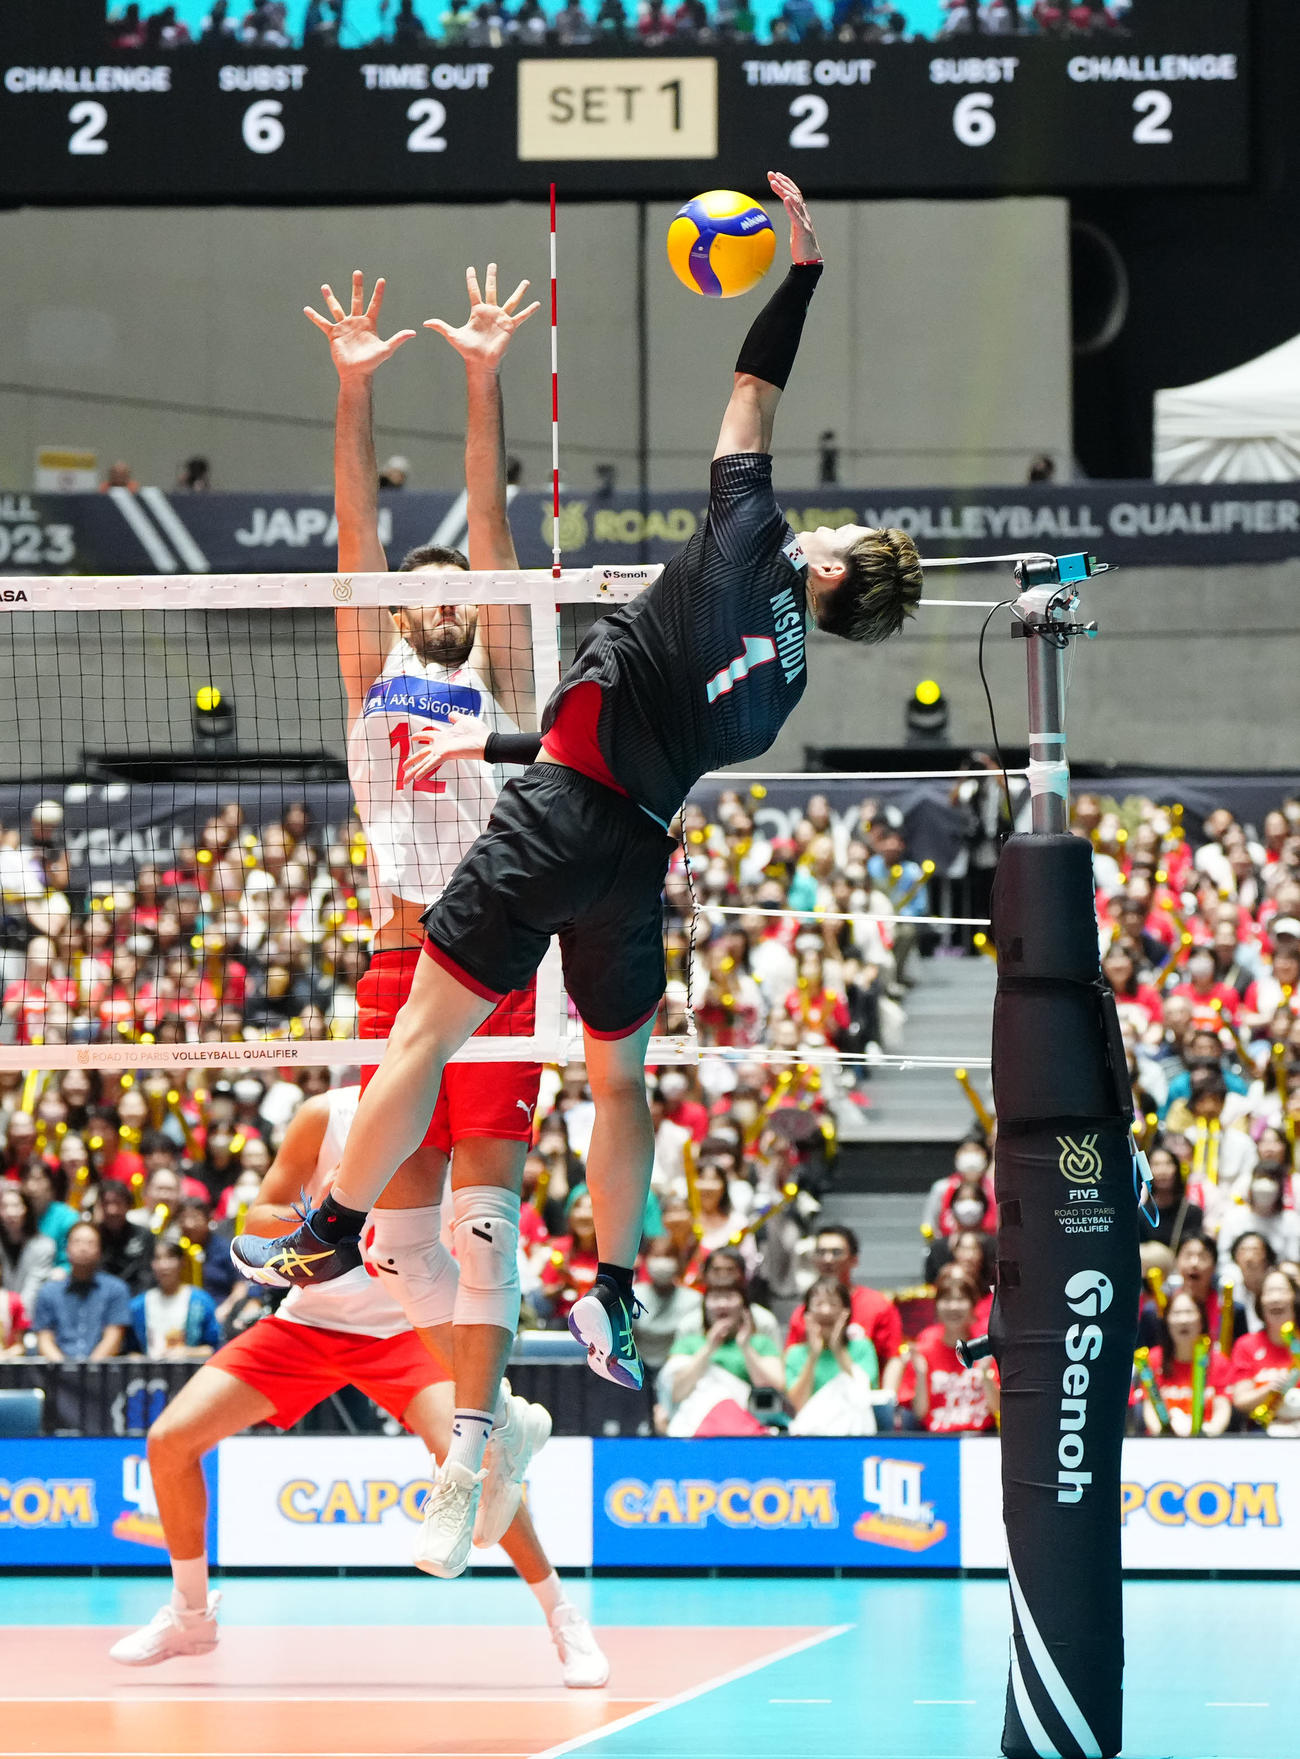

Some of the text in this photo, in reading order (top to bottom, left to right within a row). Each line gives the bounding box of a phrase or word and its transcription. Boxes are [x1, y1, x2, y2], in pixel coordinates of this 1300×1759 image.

[5, 65, 171, 93] CHALLENGE
[219, 65, 307, 92] SUBST
[361, 63, 493, 90] TIME OUT
[742, 59, 876, 86] TIME OUT
[929, 57, 1019, 84] SUBST
[1067, 53, 1237, 82] CHALLENGE
[549, 79, 683, 131] SET 1
[789, 95, 829, 149] 2
[953, 92, 996, 147] 6
[1133, 90, 1173, 144] 2
[68, 101, 108, 155] 2
[242, 100, 285, 154] 6
[407, 98, 447, 153] 2
[234, 507, 393, 547] JAP
[594, 509, 697, 543] ROAD
[863, 503, 1104, 541] VOLLEYBALL
[1108, 499, 1300, 537] QUALIFIER
[613, 570, 648, 579] Senoh
[769, 586, 806, 685] NISHIDA
[706, 634, 777, 704] 1
[389, 693, 416, 708] AXA
[172, 1050, 241, 1061] VOLLEYBALL
[243, 1049, 298, 1060] QUALIFIER
[1054, 1207, 1116, 1217] ROAD TO PARIS
[1069, 1188, 1099, 1200] FIVB
[1058, 1216, 1114, 1225] VOLLEYBALL
[1064, 1224, 1110, 1234] QUALIFIER
[1058, 1323, 1104, 1504] Senoh
[606, 1480, 839, 1527] CAPCOM
[1121, 1480, 1282, 1527] PCOM
